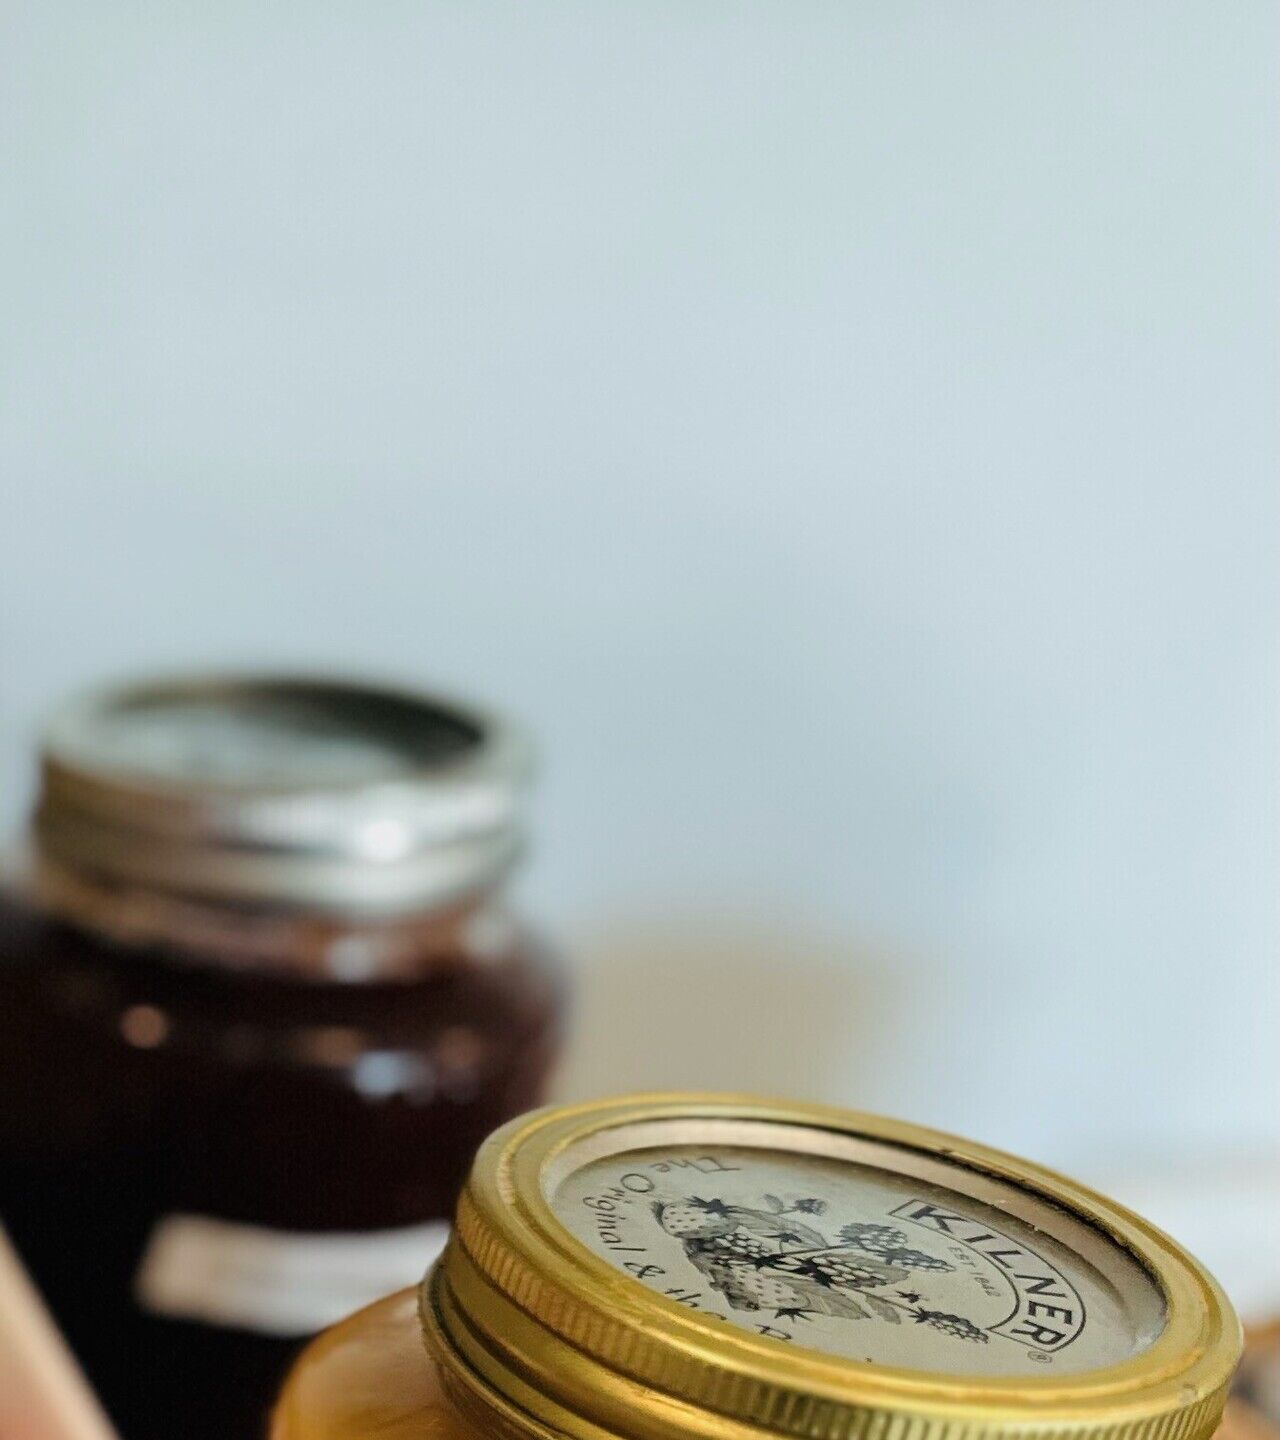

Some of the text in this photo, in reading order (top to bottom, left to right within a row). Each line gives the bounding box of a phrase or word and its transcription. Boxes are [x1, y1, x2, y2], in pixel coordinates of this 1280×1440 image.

[650, 1156, 743, 1174] The
[582, 1173, 656, 1252] Original
[909, 1205, 1074, 1346] KILNER
